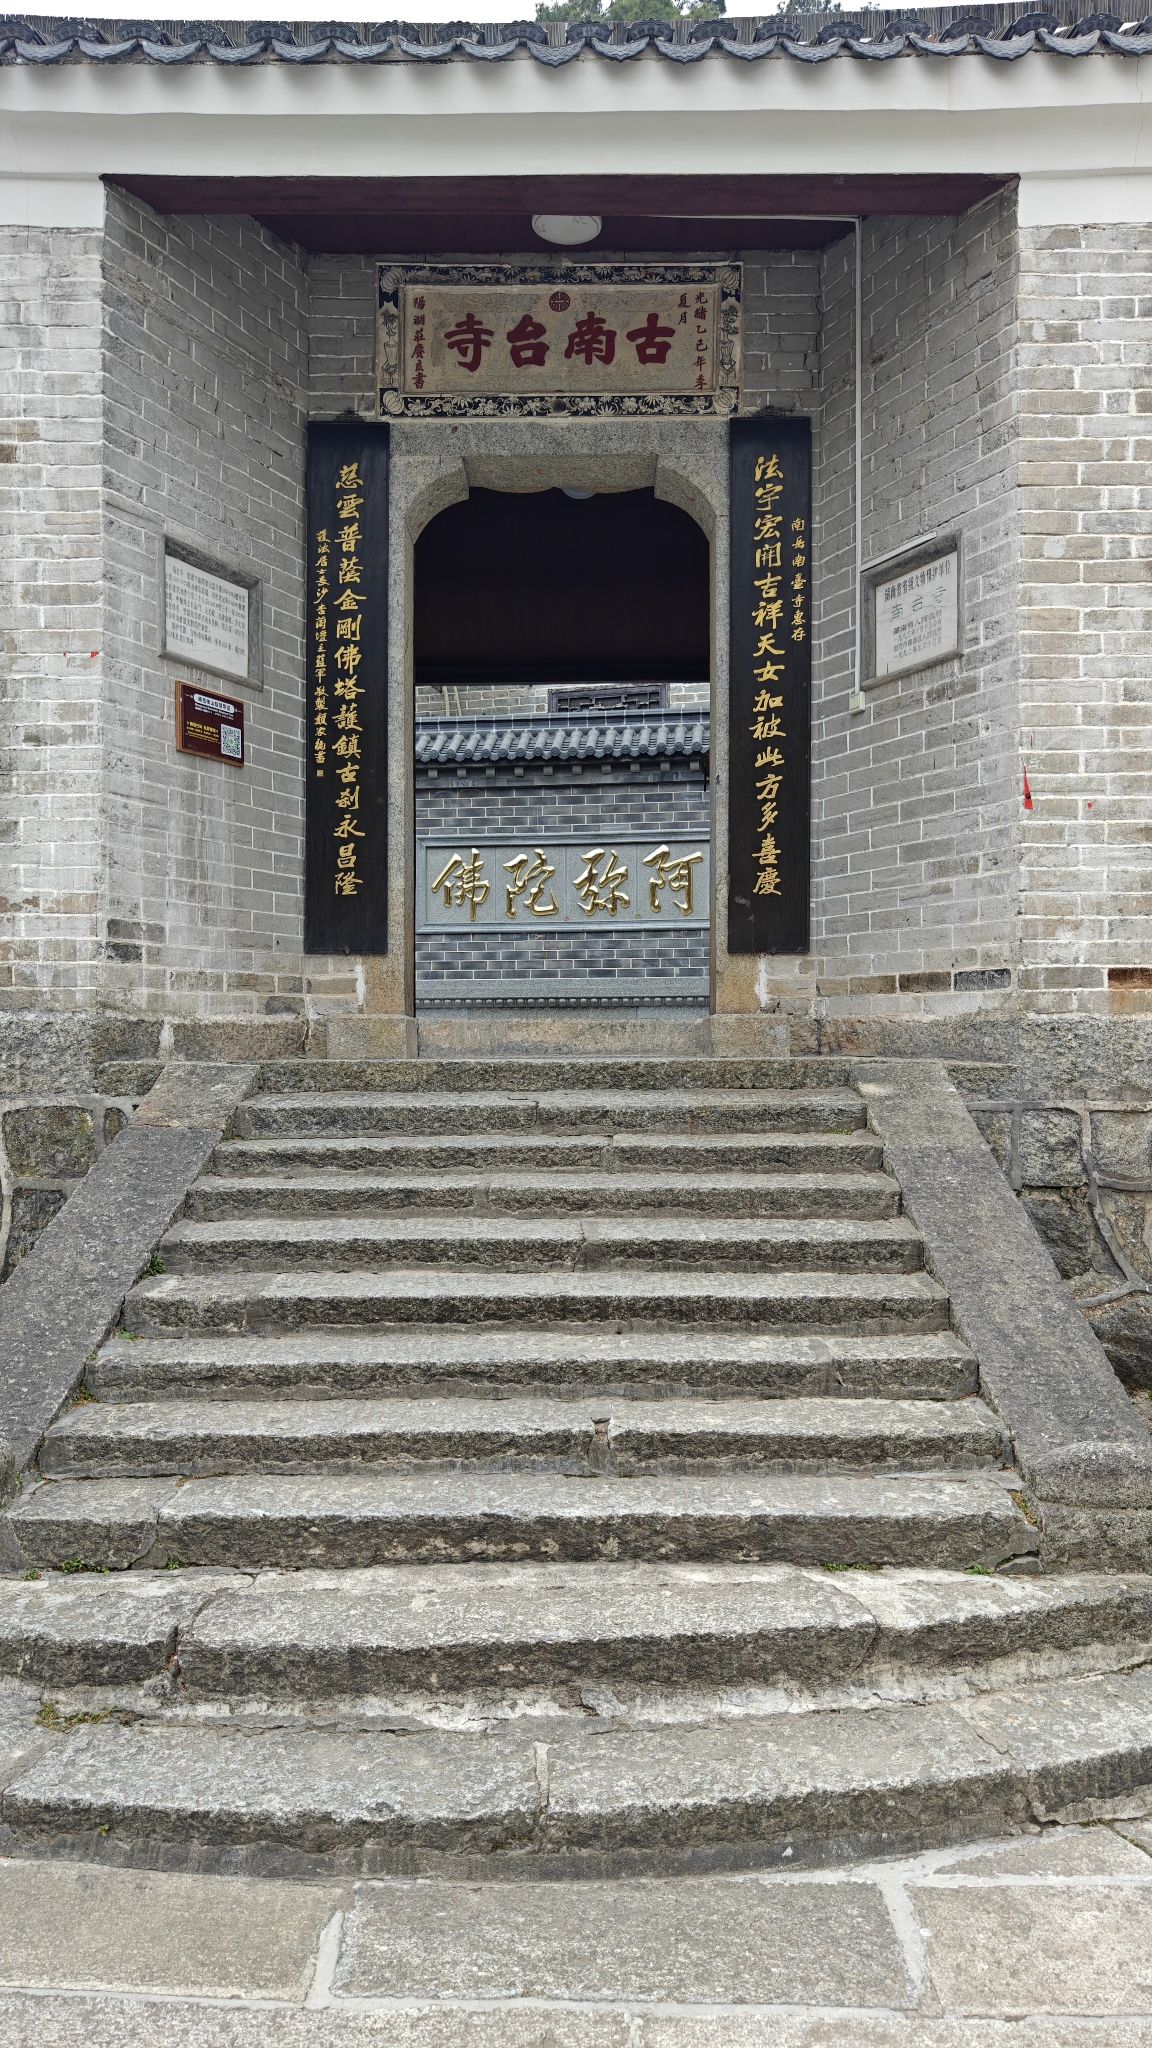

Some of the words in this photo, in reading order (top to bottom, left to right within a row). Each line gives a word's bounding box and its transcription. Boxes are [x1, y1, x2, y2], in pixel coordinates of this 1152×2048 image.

[677, 292, 691, 326] 夏月
[444, 311, 676, 373] 古南台寺
